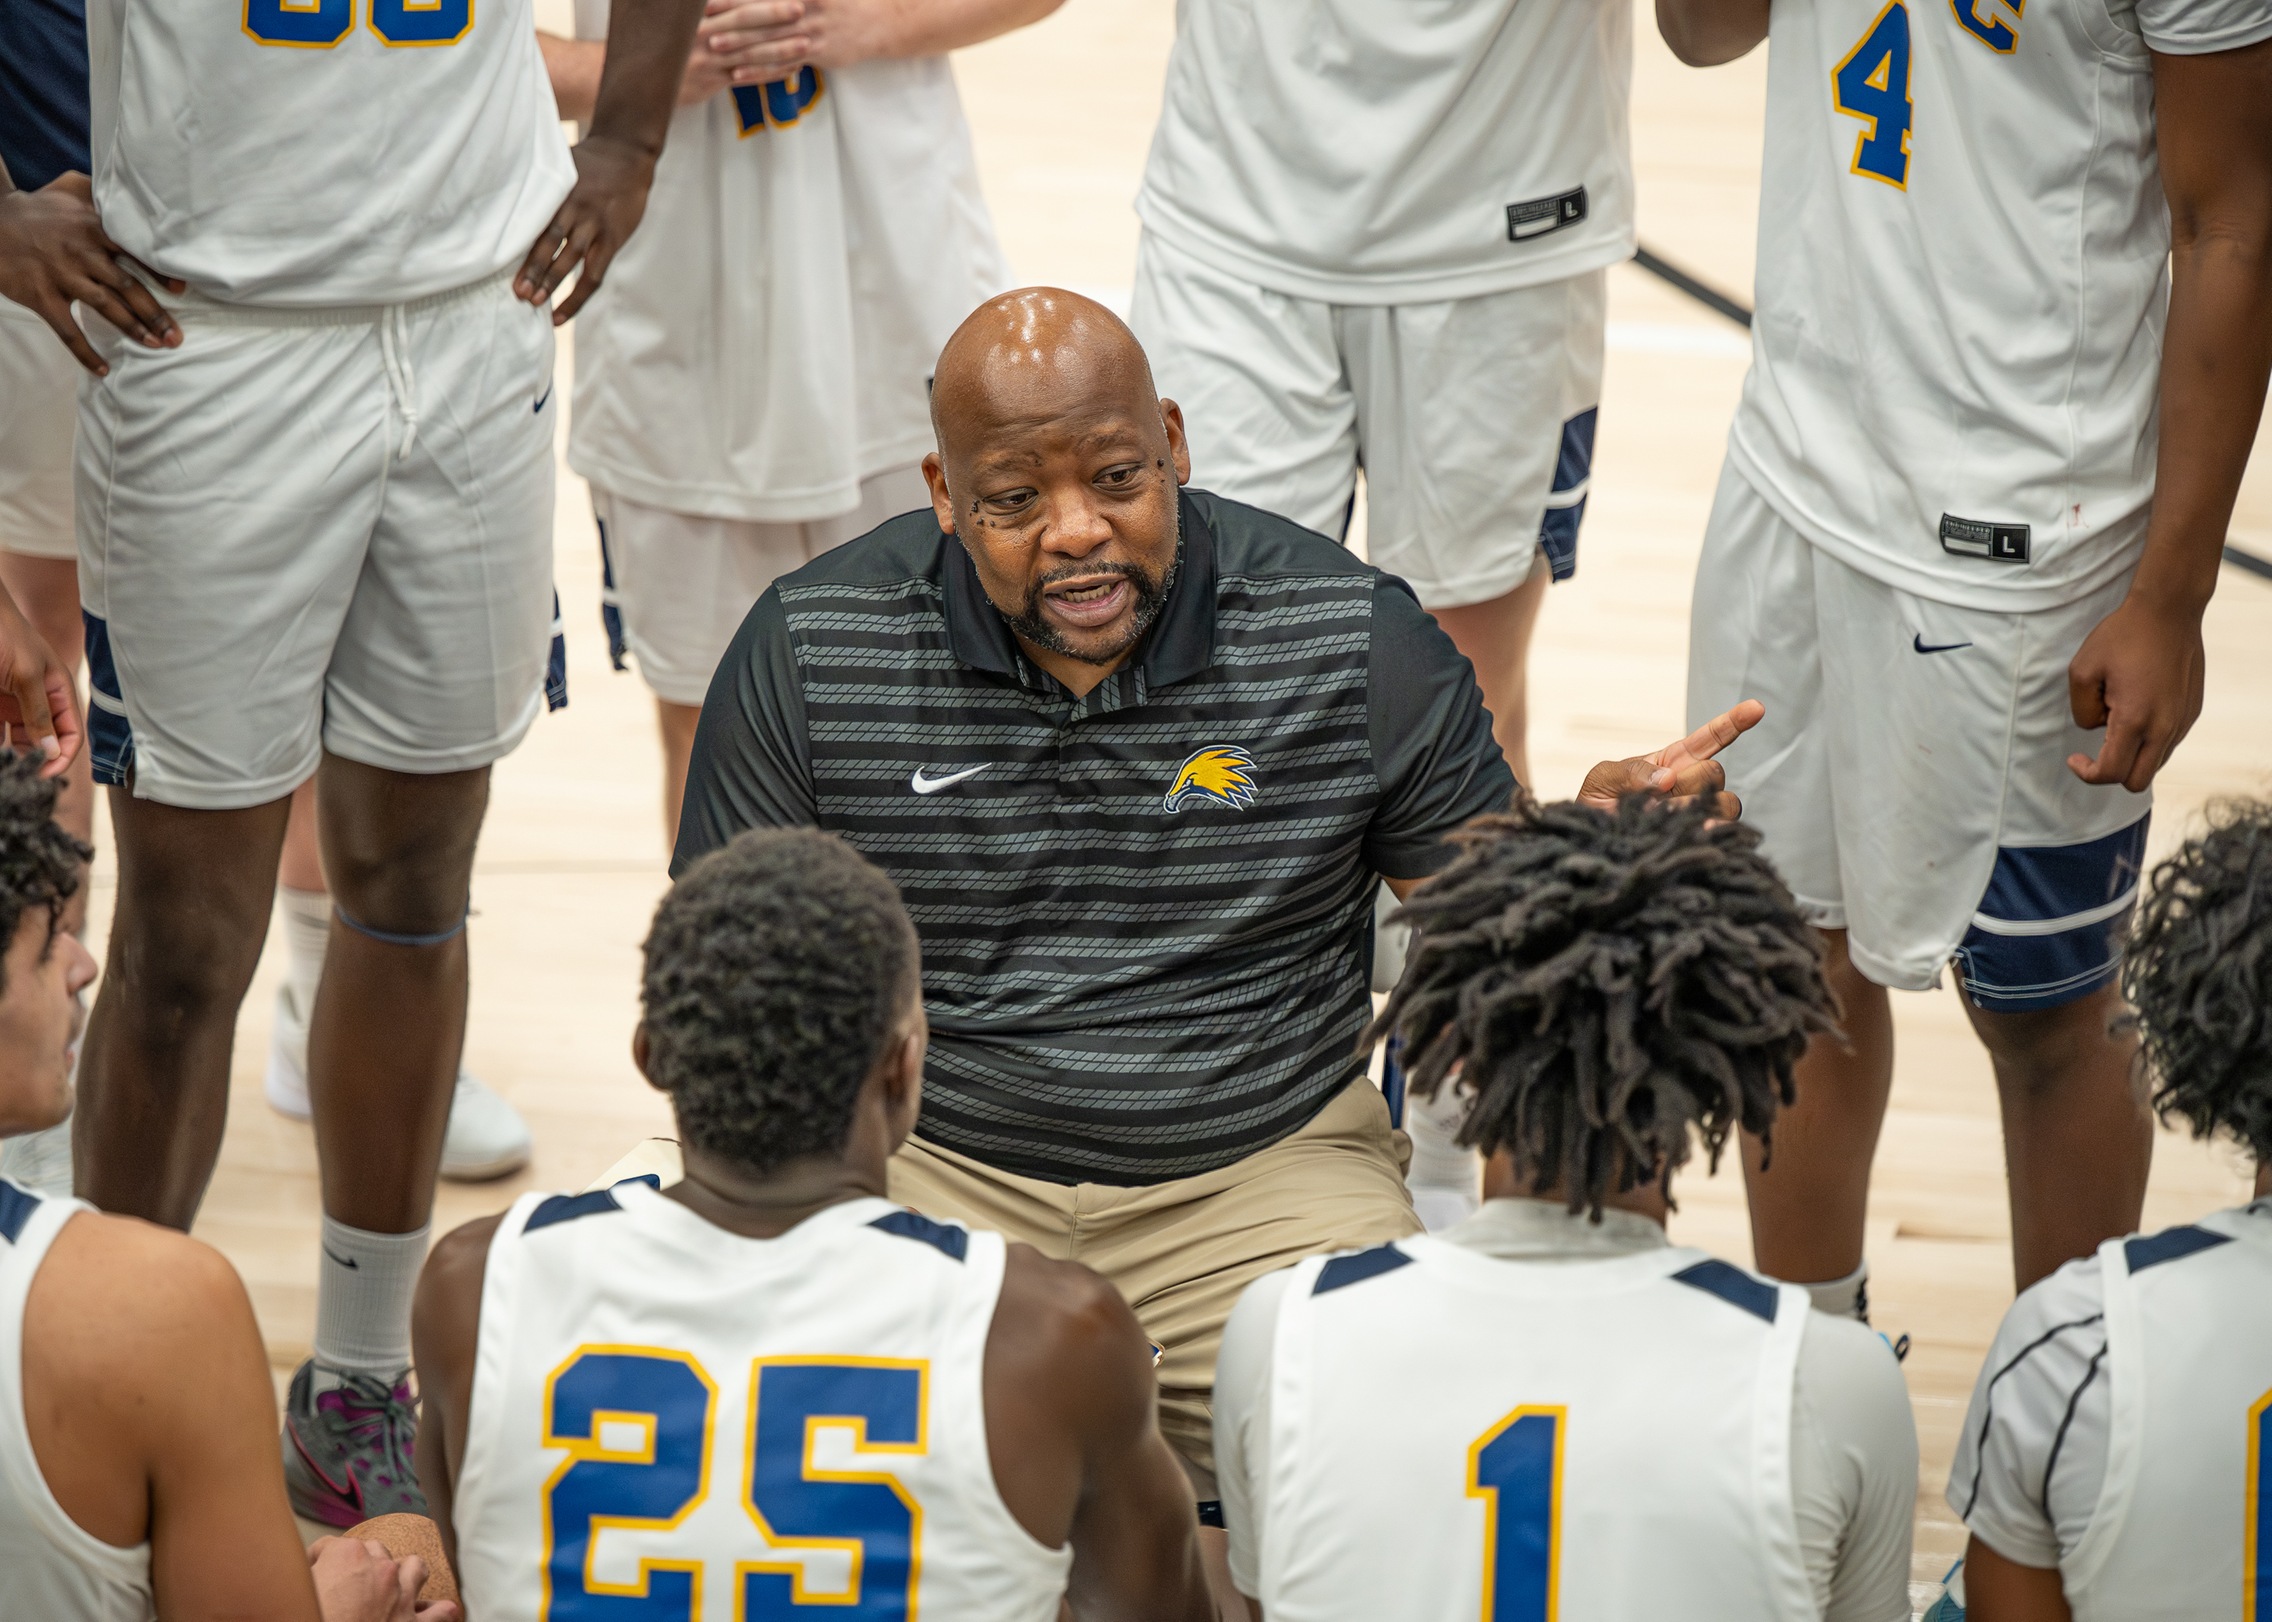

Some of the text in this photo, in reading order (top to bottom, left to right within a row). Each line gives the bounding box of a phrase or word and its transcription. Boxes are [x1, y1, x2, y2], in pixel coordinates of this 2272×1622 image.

[1830, 0, 1913, 192] 4
[1565, 201, 1578, 217] L
[2003, 535, 2015, 553] L
[539, 1344, 930, 1622] 25
[1465, 1403, 1568, 1622] 1
